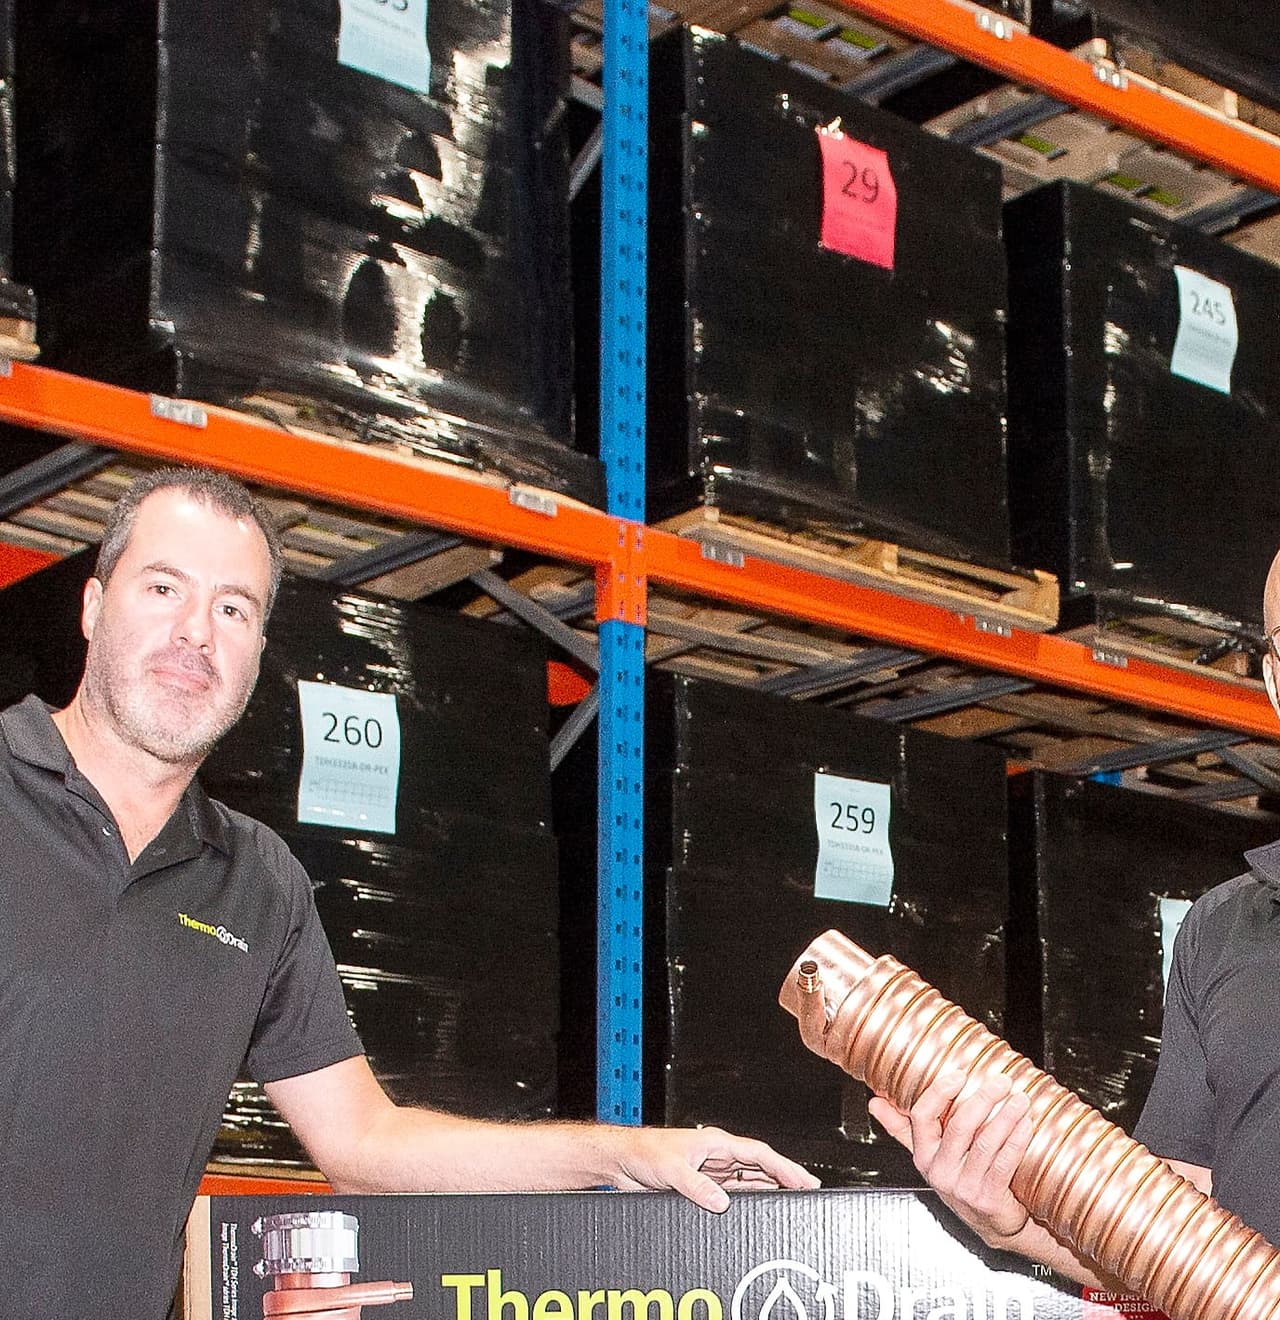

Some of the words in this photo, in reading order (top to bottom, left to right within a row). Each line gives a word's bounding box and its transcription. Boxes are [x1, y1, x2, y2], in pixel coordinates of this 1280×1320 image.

[841, 159, 879, 204] 29
[322, 711, 384, 749] 260
[829, 801, 876, 835] 259
[178, 912, 218, 937] Thermo
[1088, 1291, 1118, 1302] NEW
